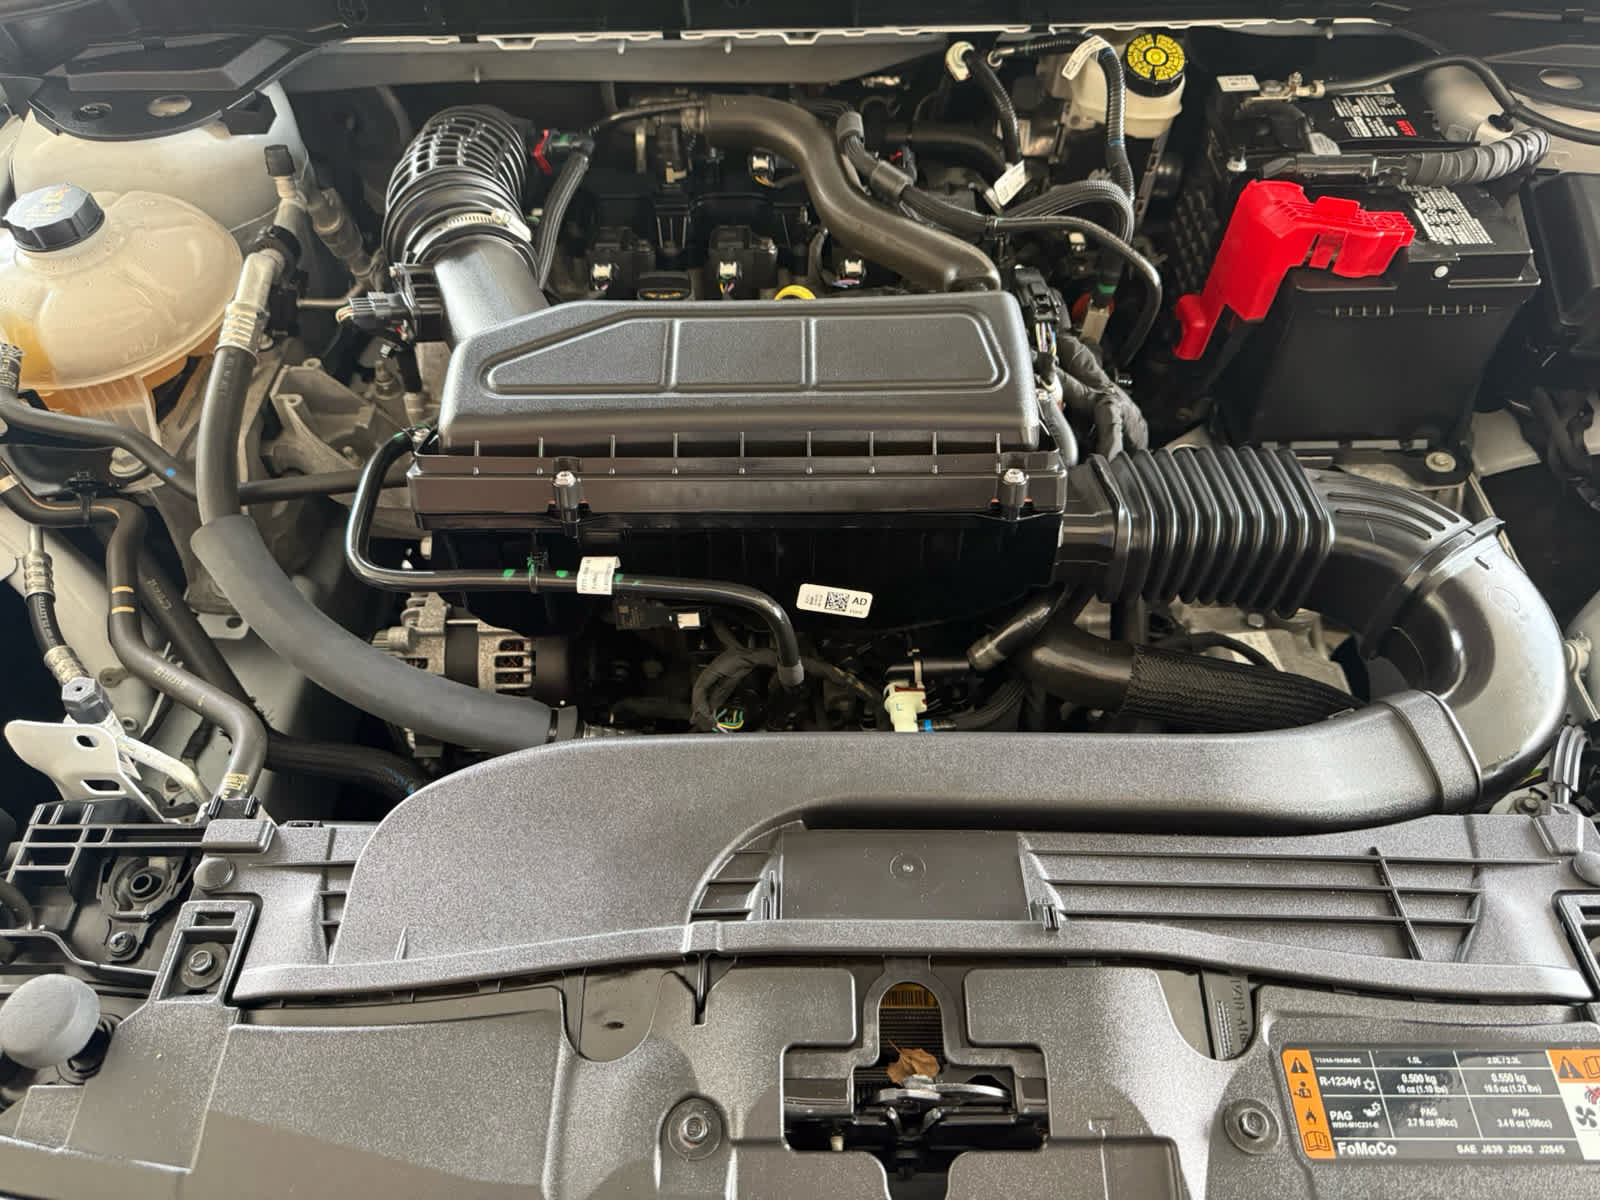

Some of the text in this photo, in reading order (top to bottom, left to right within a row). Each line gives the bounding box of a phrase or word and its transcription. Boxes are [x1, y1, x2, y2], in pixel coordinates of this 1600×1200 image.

[852, 597, 868, 606] AD
[1319, 1076, 1361, 1089] R-1234yf
[1401, 1073, 1437, 1086] 0.500 kg
[1491, 1072, 1528, 1085] 0.550 kg
[1500, 1085, 1509, 1093] oz
[1329, 1110, 1353, 1121] PAG
[1420, 1107, 1438, 1117] PAG
[1512, 1107, 1530, 1117] PAG
[1425, 1119, 1435, 1127] oz
[1515, 1120, 1525, 1128] oz
[1337, 1141, 1397, 1156] FoMoCo
[1456, 1144, 1478, 1154] SAE
